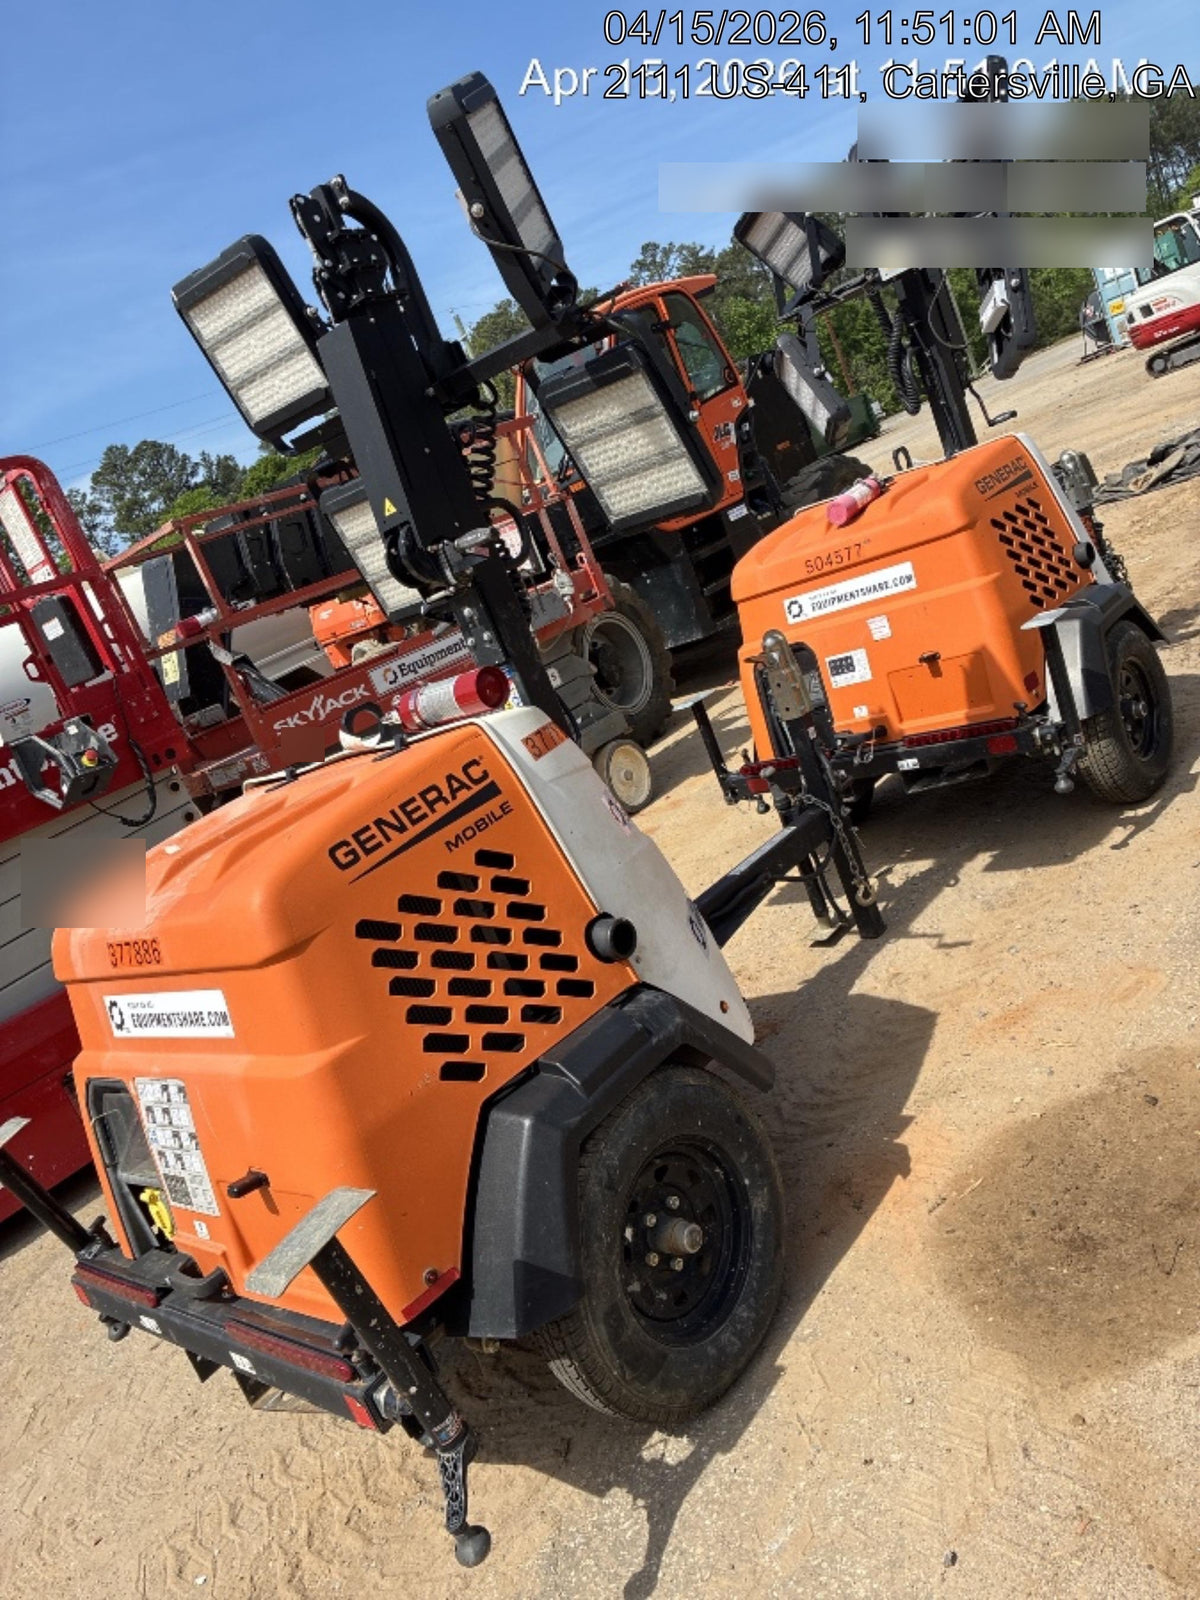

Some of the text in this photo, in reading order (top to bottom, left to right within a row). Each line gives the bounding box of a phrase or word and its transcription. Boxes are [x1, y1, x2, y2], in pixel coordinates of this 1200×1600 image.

[974, 455, 1028, 494] GENERAC
[327, 757, 490, 872] GENERAC
[443, 799, 514, 853] MOBILE
[106, 937, 161, 969] 377886
[129, 1010, 230, 1030] EQUIPMENTSHARE.COM
